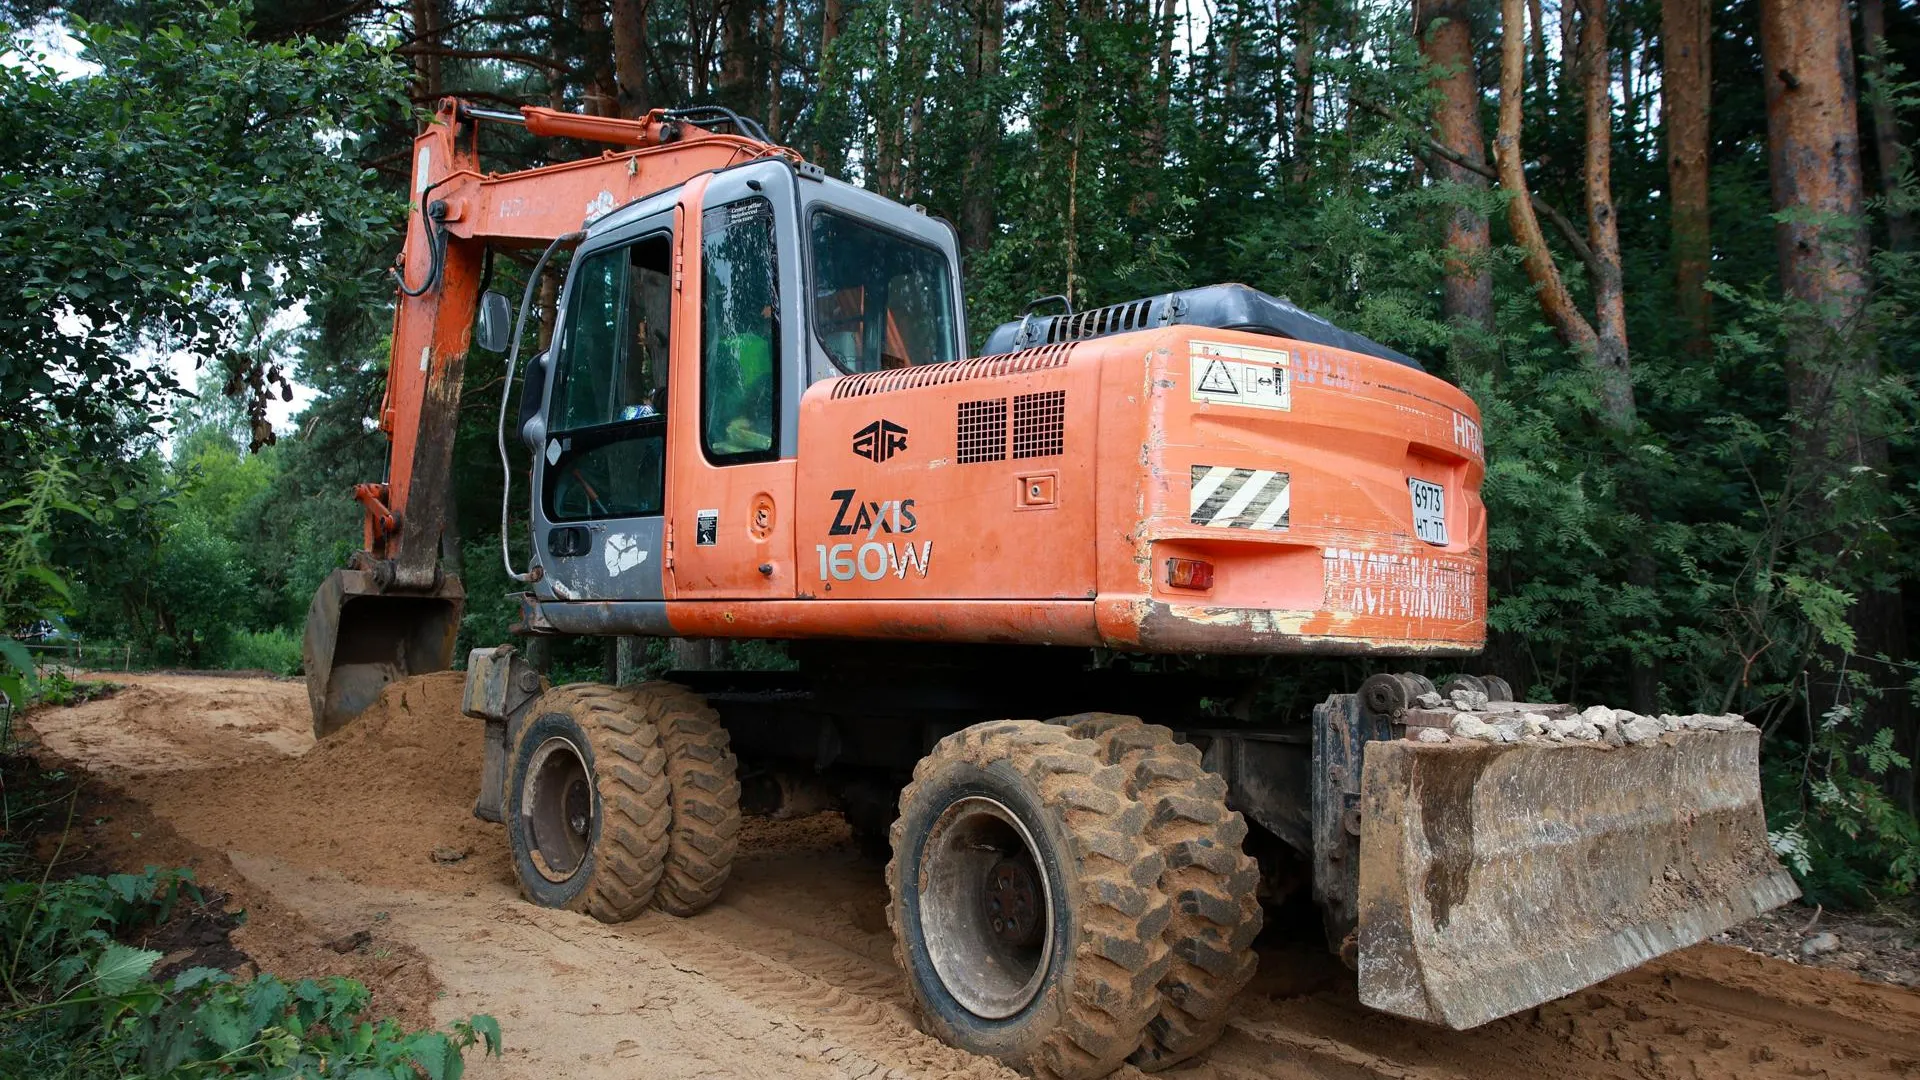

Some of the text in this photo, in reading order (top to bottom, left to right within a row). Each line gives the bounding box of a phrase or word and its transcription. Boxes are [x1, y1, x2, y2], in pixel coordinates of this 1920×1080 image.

[828, 488, 917, 540] ZAXIS
[1415, 483, 1440, 512] 6973
[1433, 521, 1444, 541] 77
[815, 540, 933, 581] 160W
